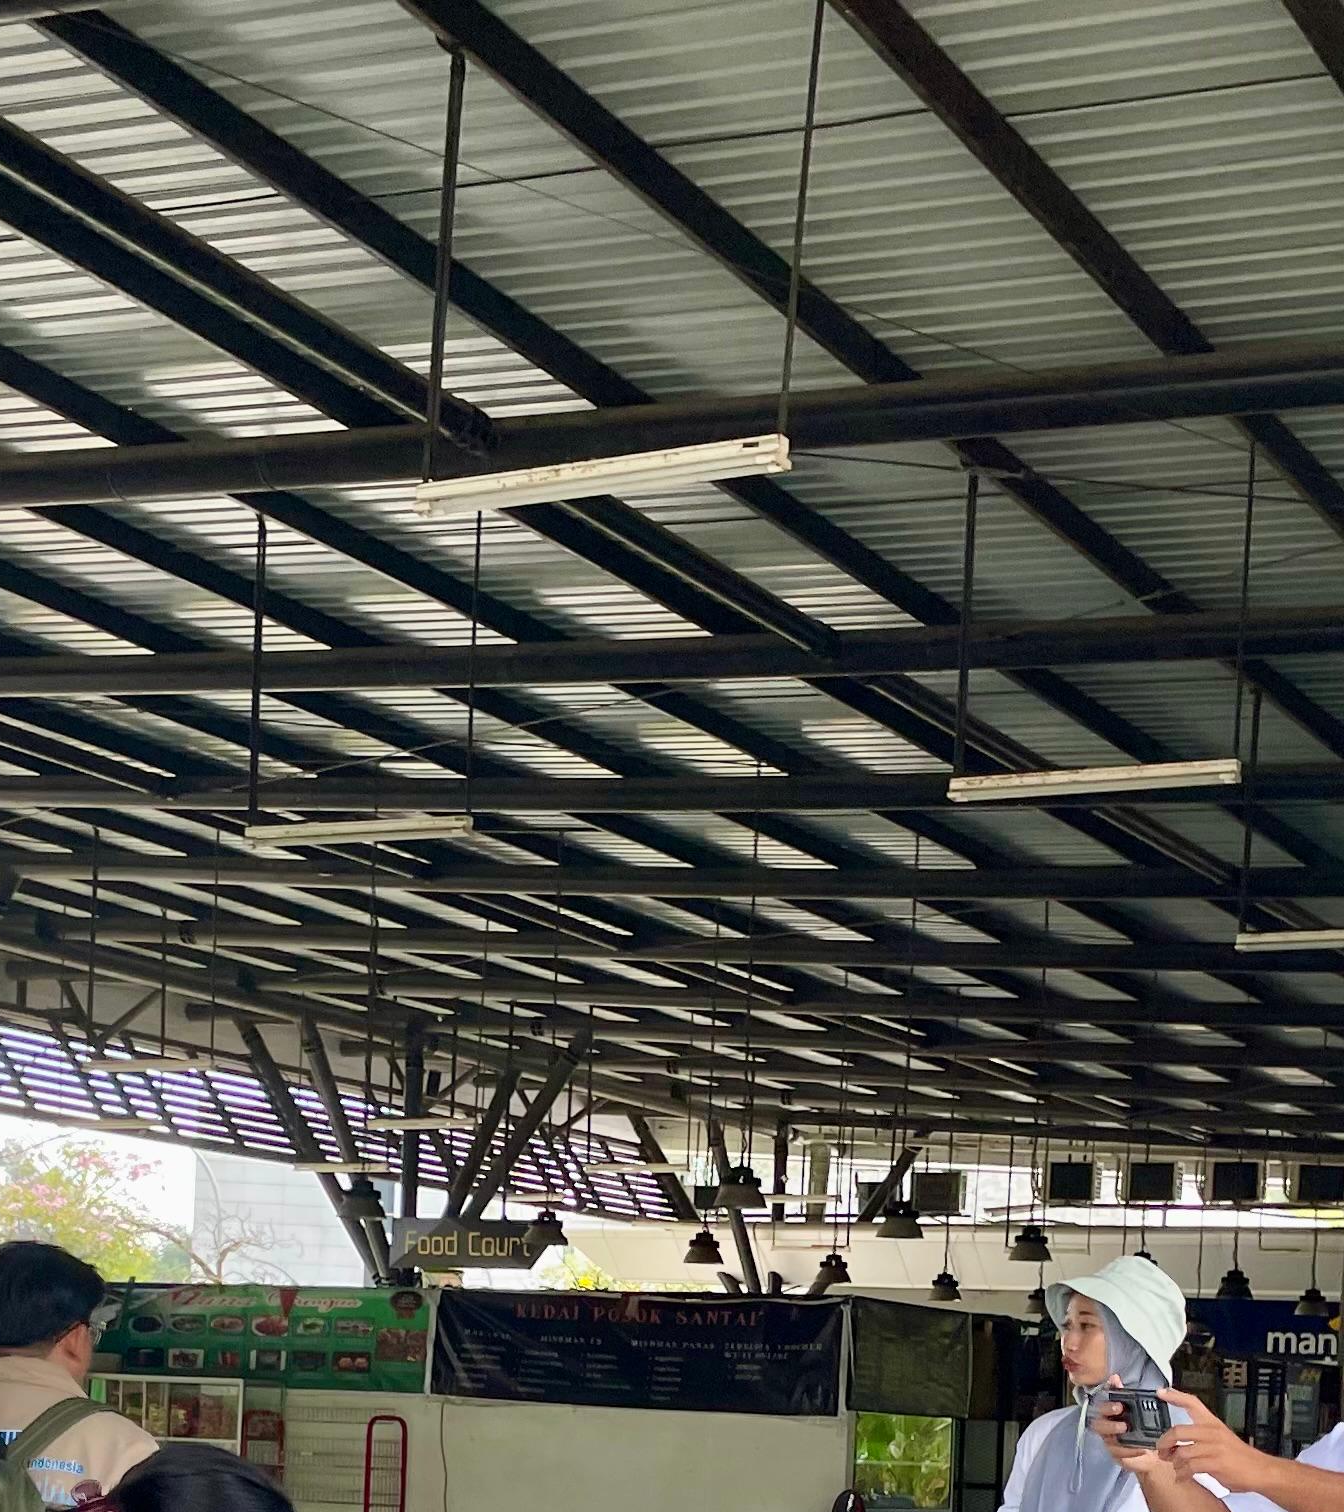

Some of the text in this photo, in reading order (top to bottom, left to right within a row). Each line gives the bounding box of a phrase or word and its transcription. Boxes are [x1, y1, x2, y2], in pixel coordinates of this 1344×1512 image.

[405, 1230, 531, 1257] Food Court
[515, 1303, 579, 1321] KEDAI
[1266, 1331, 1338, 1355] man
